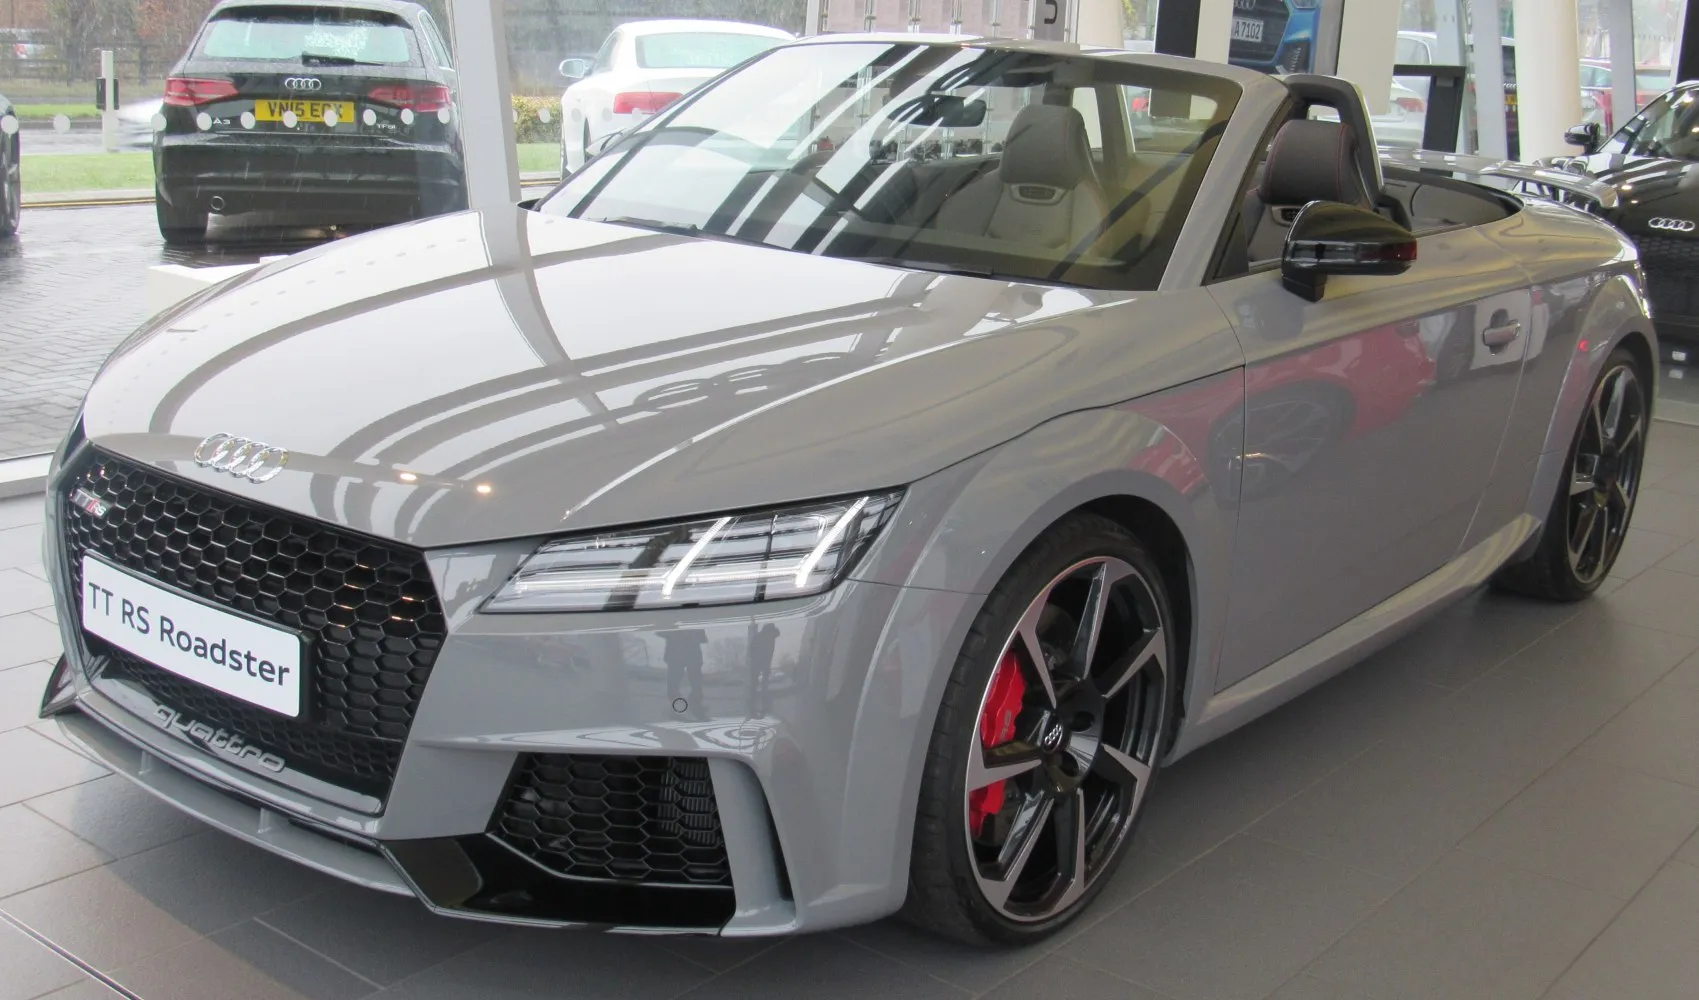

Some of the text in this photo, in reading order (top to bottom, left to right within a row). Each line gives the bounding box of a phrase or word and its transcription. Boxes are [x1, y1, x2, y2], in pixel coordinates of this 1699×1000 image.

[213, 116, 231, 125] A3
[267, 101, 305, 117] VN15
[88, 582, 291, 686] TT RS Roadster
[154, 704, 286, 772] quattro
